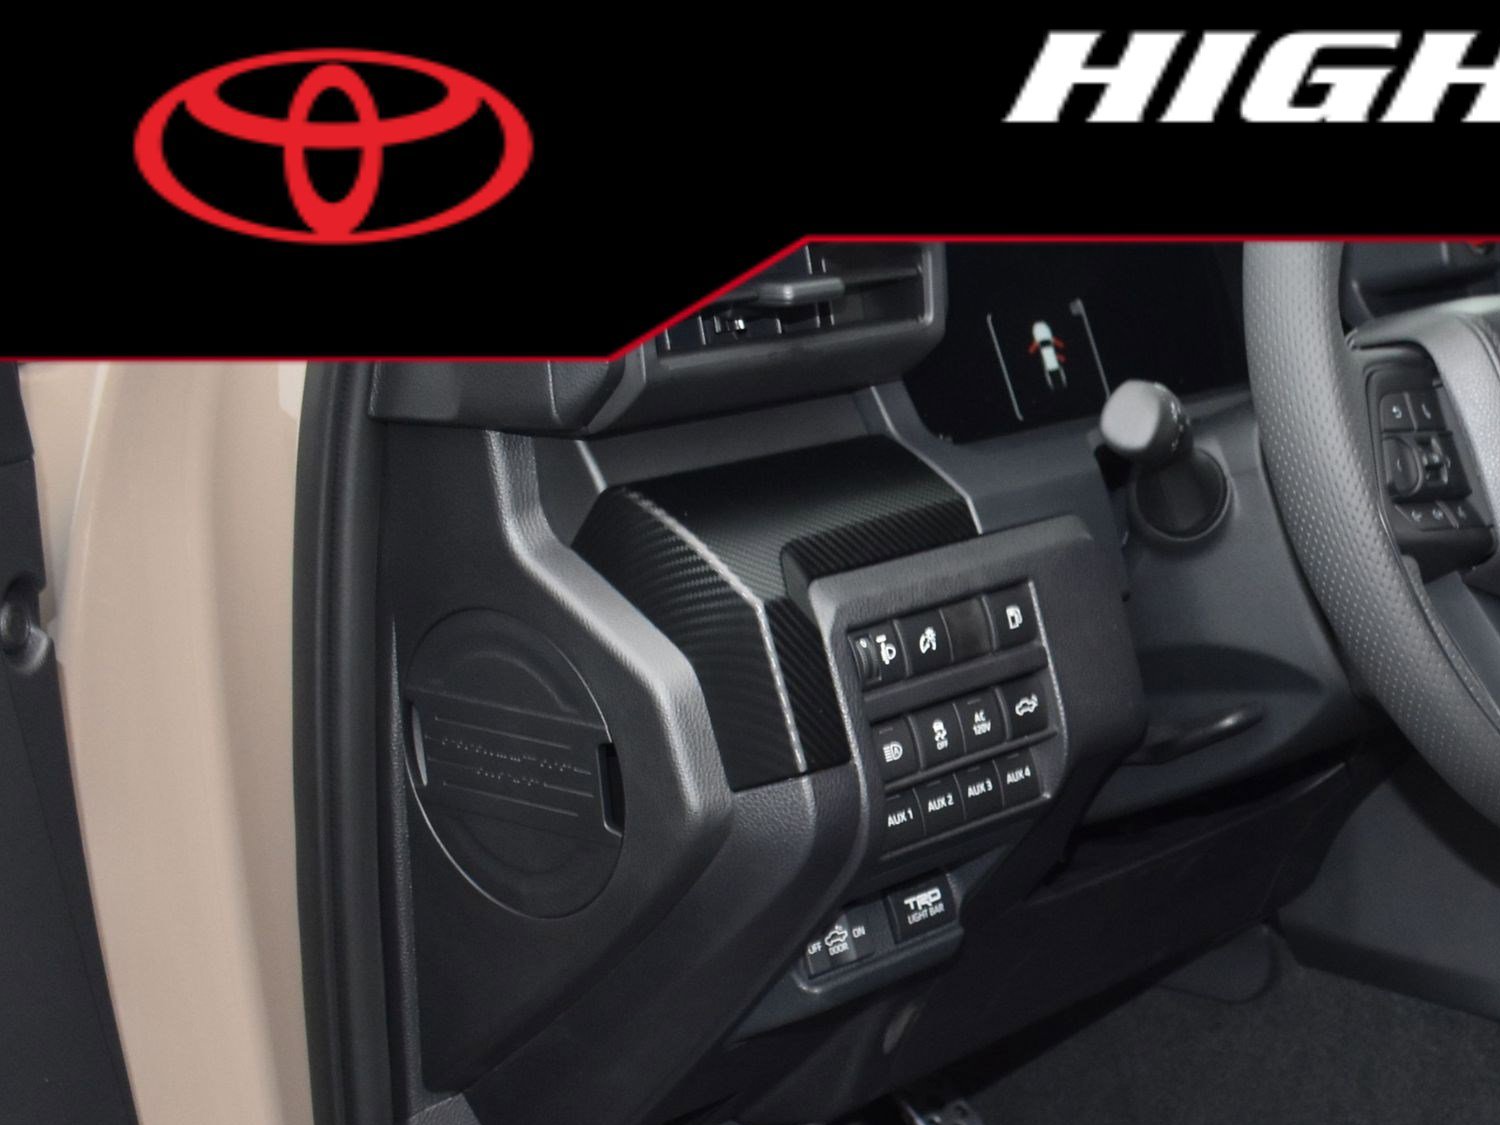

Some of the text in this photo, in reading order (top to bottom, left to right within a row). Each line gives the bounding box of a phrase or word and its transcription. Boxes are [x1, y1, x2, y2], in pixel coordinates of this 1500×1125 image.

[973, 709, 986, 723] AC
[1006, 765, 1031, 785] AUX 4
[967, 778, 993, 798] AUX 3
[927, 793, 955, 813] AUX 2
[887, 807, 914, 827] AUX 1
[903, 887, 942, 911] TRD
[907, 902, 945, 925] LIGHT BAR
[852, 925, 866, 939] ON
